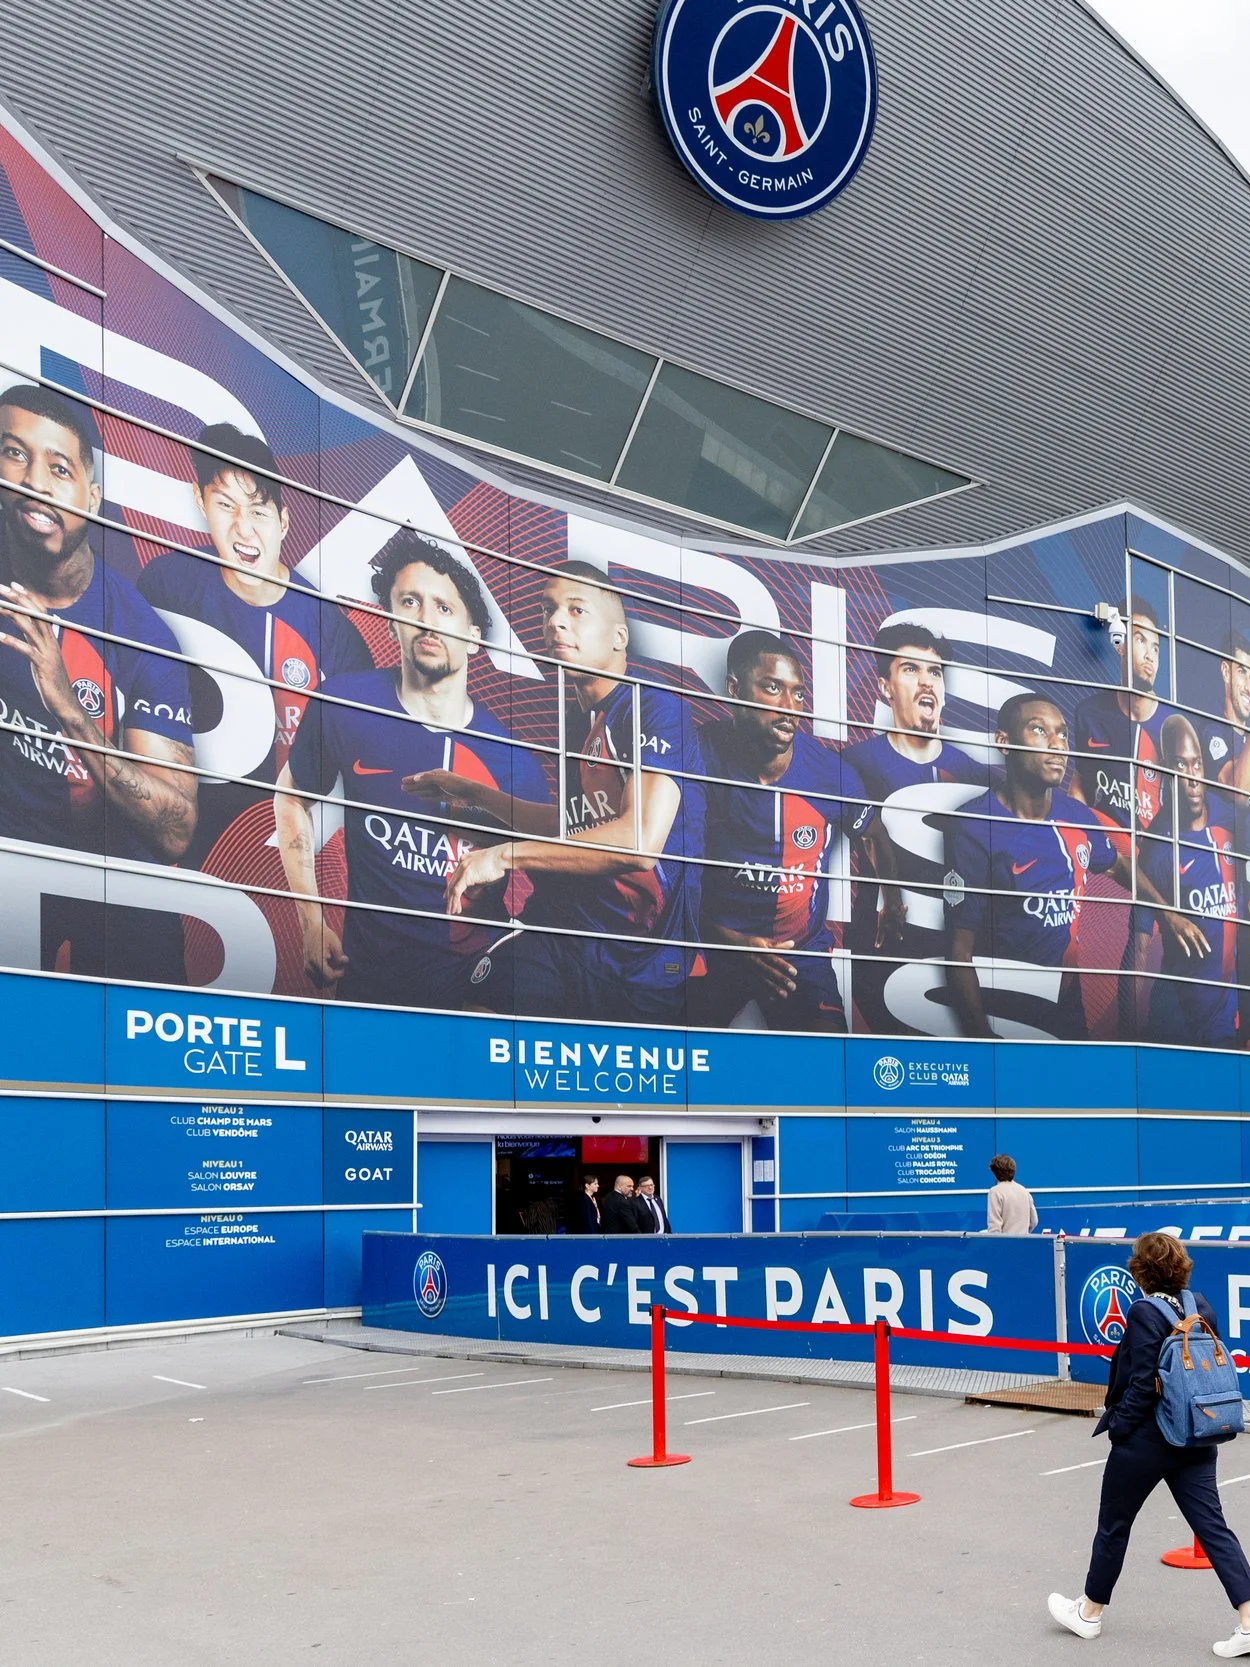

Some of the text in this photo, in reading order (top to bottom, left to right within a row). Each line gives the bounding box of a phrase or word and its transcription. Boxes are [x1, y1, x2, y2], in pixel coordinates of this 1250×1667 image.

[688, 106, 727, 165] SAINT
[738, 167, 814, 191] GERMAIN
[77, 681, 100, 695] PARIS
[13, 735, 88, 780] AIRWAY
[392, 849, 459, 877] AIRWA
[1189, 881, 1236, 912] QATAR
[127, 1009, 306, 1071] PORTE L
[489, 1038, 710, 1072] BIENVENUE
[183, 1049, 262, 1077] GATE
[909, 1062, 969, 1071] EXECUTIVE
[524, 1069, 677, 1094] WELCOME
[941, 1073, 969, 1082] QATAR
[201, 1106, 236, 1114] NIVEAU
[170, 1116, 272, 1126] CLUB CHAMP DE MARS
[186, 1127, 258, 1137] CLUB VENDÔME
[345, 1130, 393, 1145] QATAR
[356, 1143, 393, 1151] AIRWAYS
[202, 1160, 237, 1168] NIVEAU
[187, 1172, 219, 1180] SALON
[345, 1168, 393, 1181] GOAT
[191, 1183, 254, 1191] SALON ORSAY
[200, 1214, 243, 1223] NIVEAU 0
[184, 1225, 259, 1235] ESPACE EUROPE
[165, 1236, 276, 1248] ESPACE INTERNATIONAL
[419, 1254, 441, 1270] PARIS
[1090, 1271, 1136, 1295] PARIS
[487, 1263, 994, 1337] ICI C'EST PARIS
